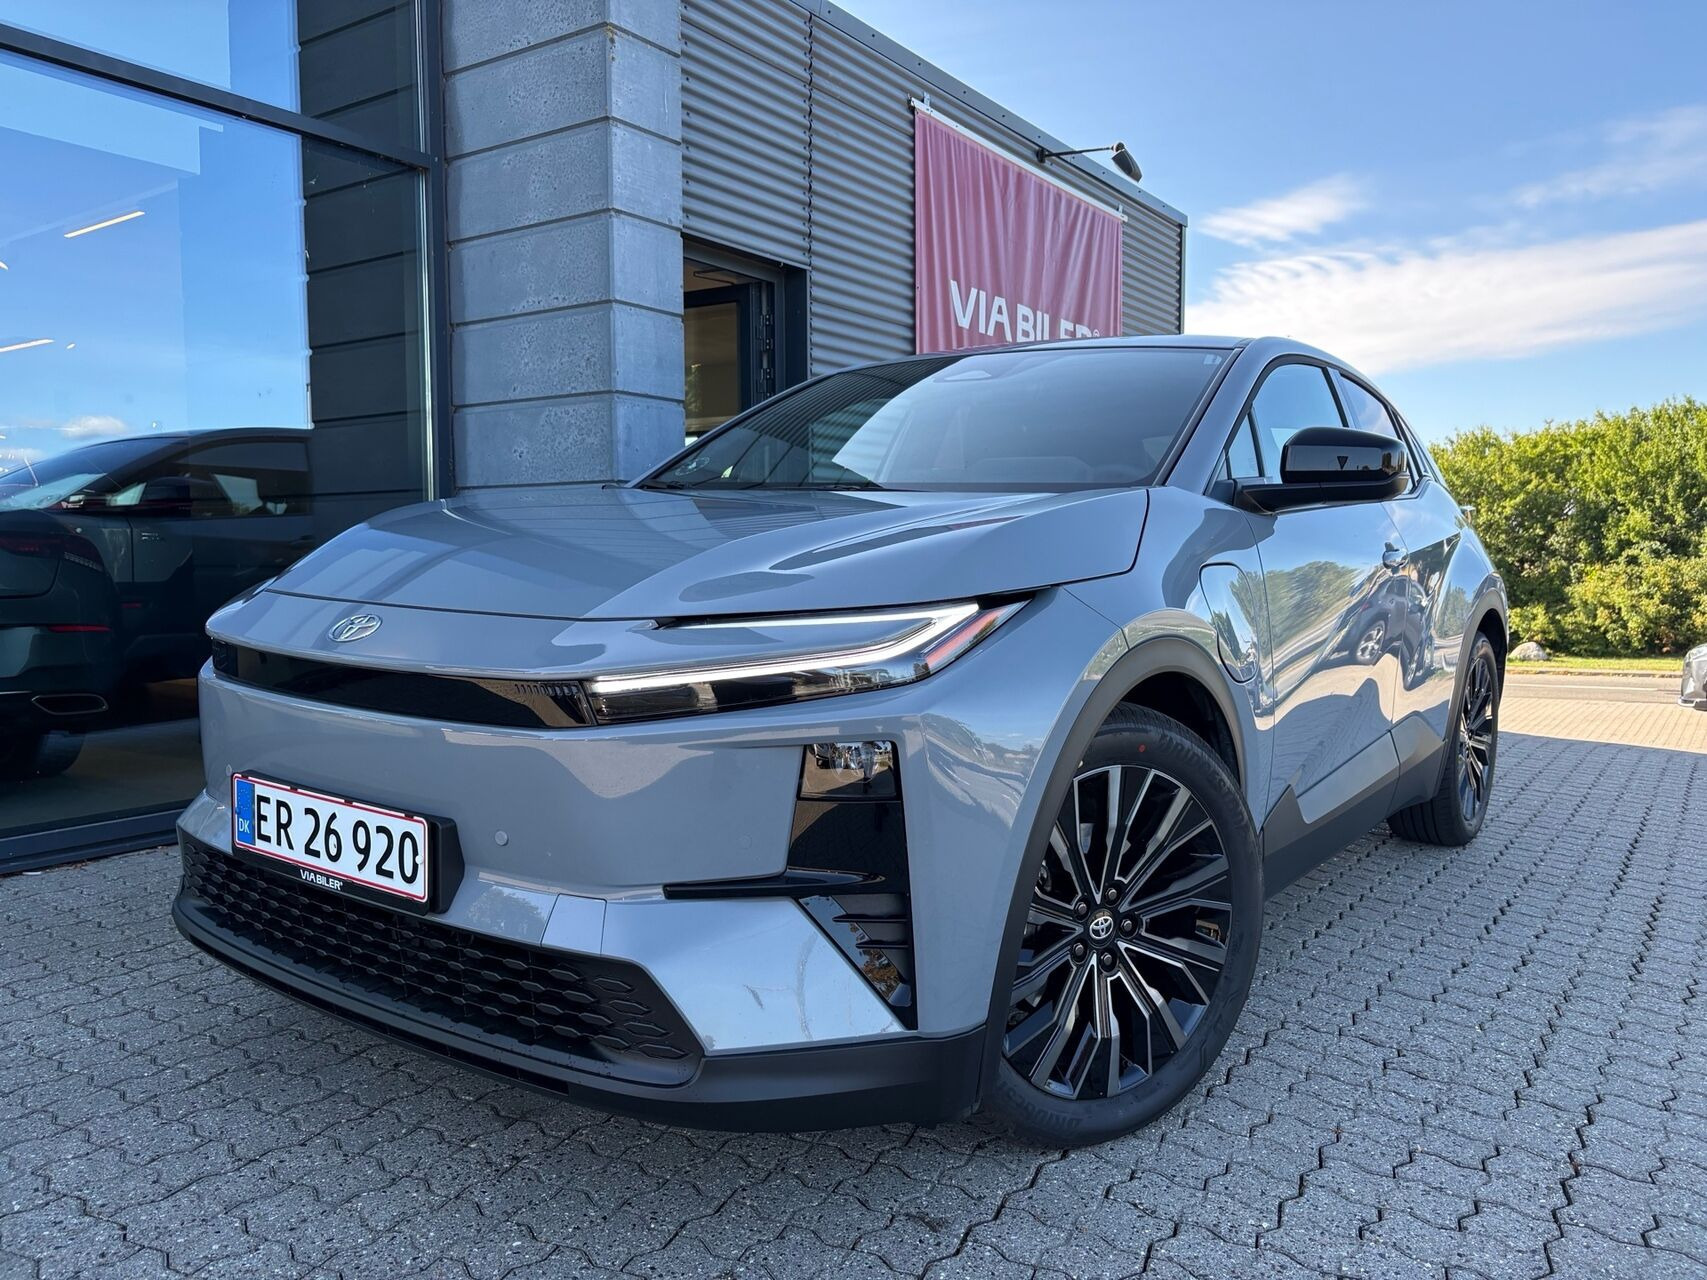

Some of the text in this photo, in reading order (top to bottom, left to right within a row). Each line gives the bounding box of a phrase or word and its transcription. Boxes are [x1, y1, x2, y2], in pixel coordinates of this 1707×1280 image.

[238, 818, 250, 834] DK
[256, 794, 419, 884] ER 26 920
